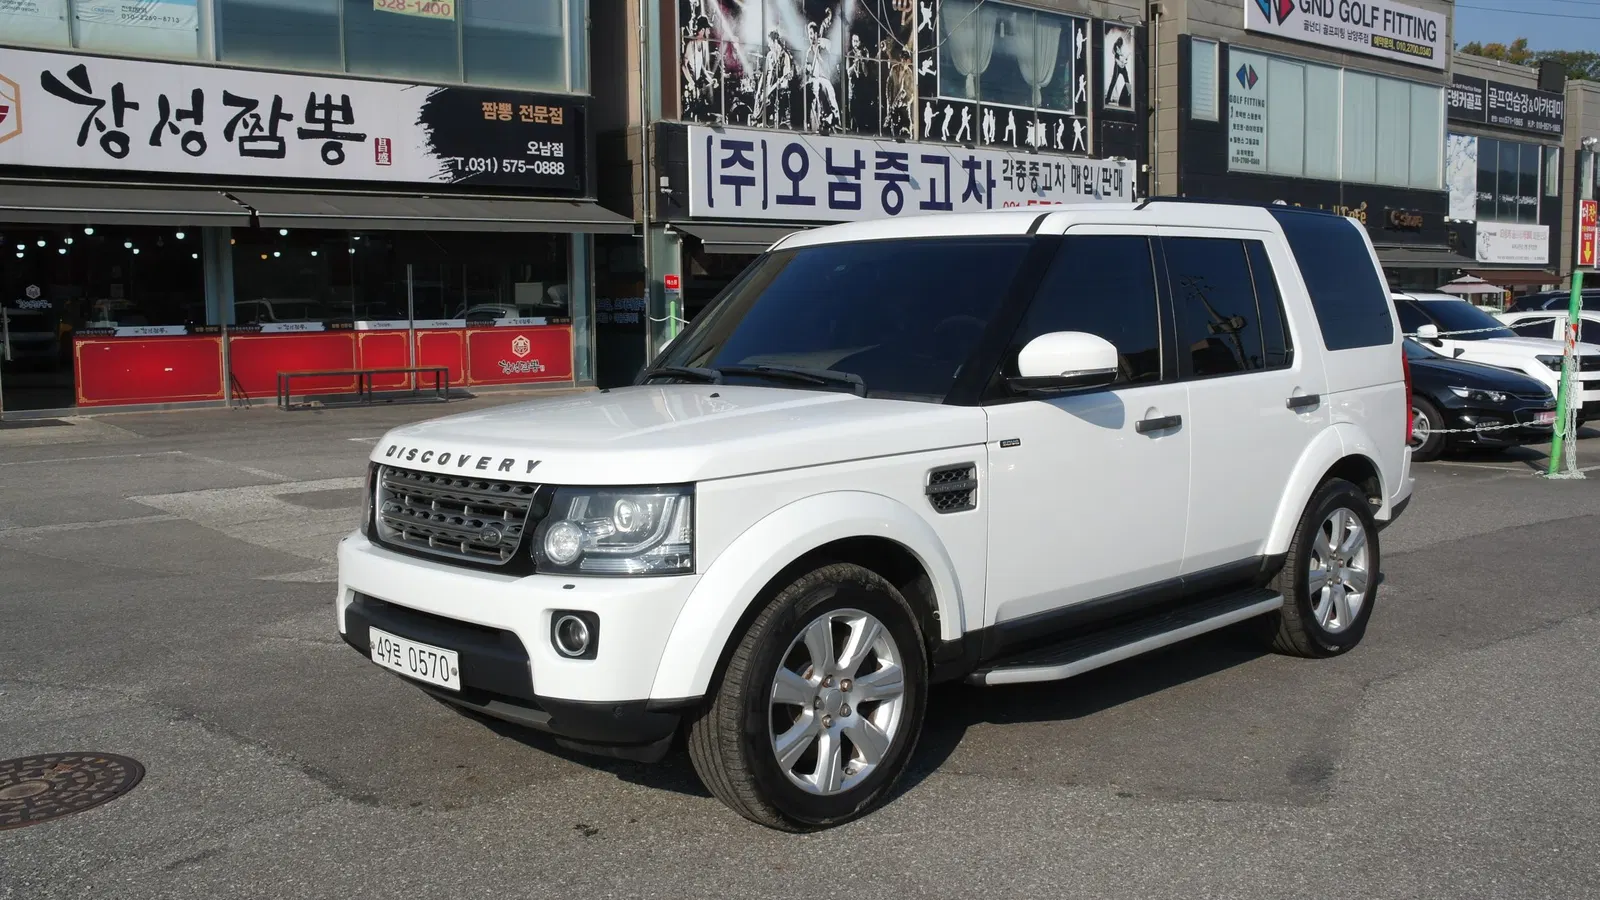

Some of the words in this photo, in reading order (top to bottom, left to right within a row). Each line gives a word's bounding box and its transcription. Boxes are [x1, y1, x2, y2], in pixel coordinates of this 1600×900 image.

[1300, 0, 1334, 19] GND
[1339, 0, 1379, 28] GOLF
[1384, 10, 1437, 43] FITTING
[1323, 22, 1345, 40] 골프피팅
[1347, 27, 1369, 44] 남양주점
[40, 63, 367, 165] 창성짬뽕
[482, 102, 513, 121] 짬뽕
[519, 105, 563, 125] 전문점
[1229, 94, 1243, 105] GOLF
[1244, 96, 1265, 108] FITTING
[1447, 89, 1482, 111] 벙커골프
[1488, 87, 1563, 120] 골프연습장&아카데미
[527, 141, 564, 157] 오남점
[502, 159, 565, 175] 575-0888
[706, 134, 996, 216] (주)오남중고차
[1002, 159, 1066, 193] 각종중고차
[1071, 165, 1123, 197] 매입/판매
[386, 445, 542, 474] DISCOVERY
[377, 636, 402, 667] 49로
[408, 647, 449, 682] 0570
